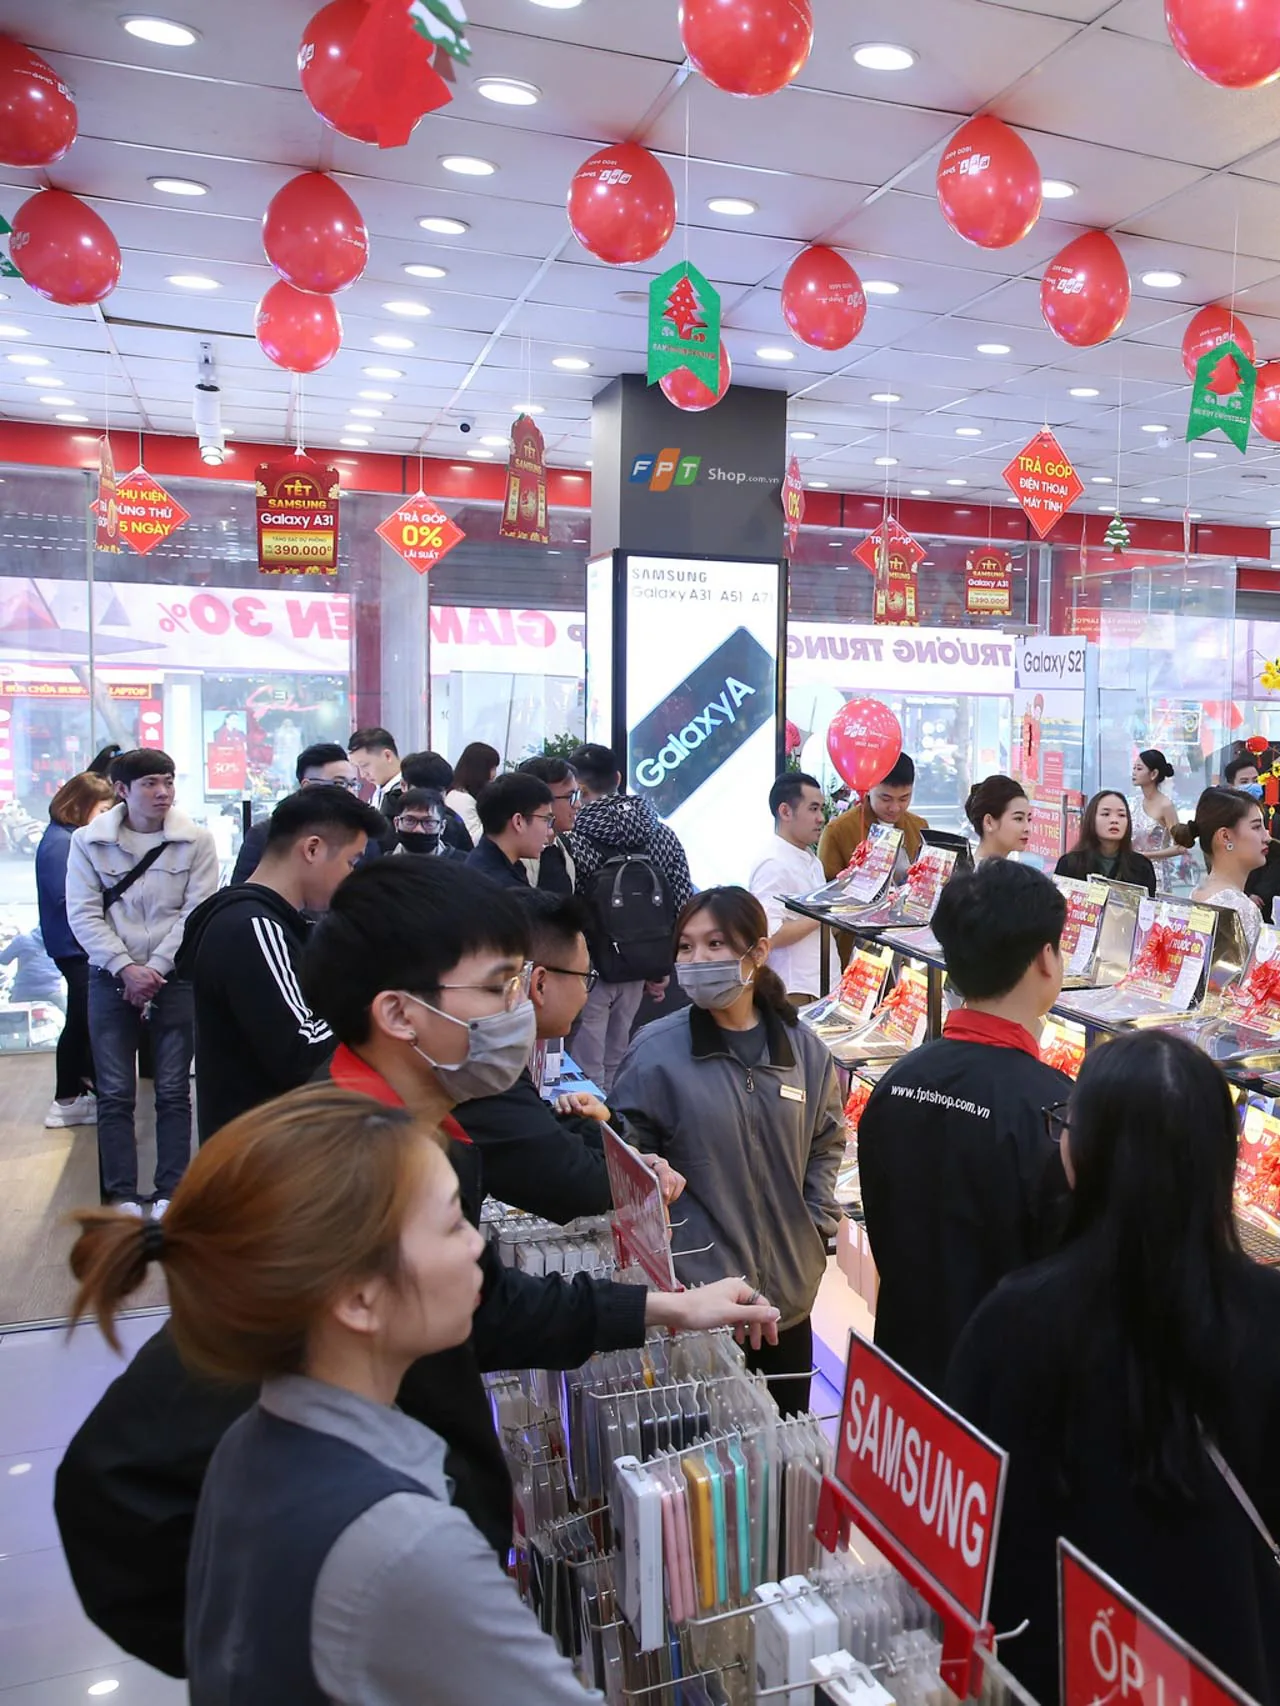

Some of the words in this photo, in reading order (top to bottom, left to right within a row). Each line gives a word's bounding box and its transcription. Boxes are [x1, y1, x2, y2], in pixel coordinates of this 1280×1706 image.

[958, 153, 991, 175] FPT
[631, 457, 698, 482] FPT
[1017, 455, 1042, 475] TRẢ
[1045, 458, 1073, 479] GÓP
[284, 480, 313, 496] TẾT
[1019, 477, 1040, 493] ĐIỆN
[1042, 480, 1069, 497] THOẠI
[140, 490, 167, 504] KIỆN
[268, 498, 327, 510] SAMSUNG
[1023, 495, 1042, 510] MÁY
[1043, 498, 1064, 513] TÍNH
[118, 503, 146, 516] ÙNG
[397, 510, 419, 524] TRẢ
[422, 511, 447, 525] GÓP
[131, 521, 171, 536] NGÀY
[261, 512, 309, 529] Galaxy
[313, 514, 334, 526] A31
[402, 525, 443, 548] 0%
[403, 549, 417, 559] LÃI
[632, 568, 708, 583] SAMSUNG
[968, 579, 995, 590] Galaxy
[631, 585, 687, 602] Galaxy
[689, 588, 712, 601] A31
[720, 590, 743, 602] A51
[1023, 651, 1066, 679] Galaxy
[890, 1083, 991, 1120] www.fptshop.com.vn
[846, 1377, 987, 1568] SAMSUNG
[1090, 1607, 1145, 1698] ỐP
